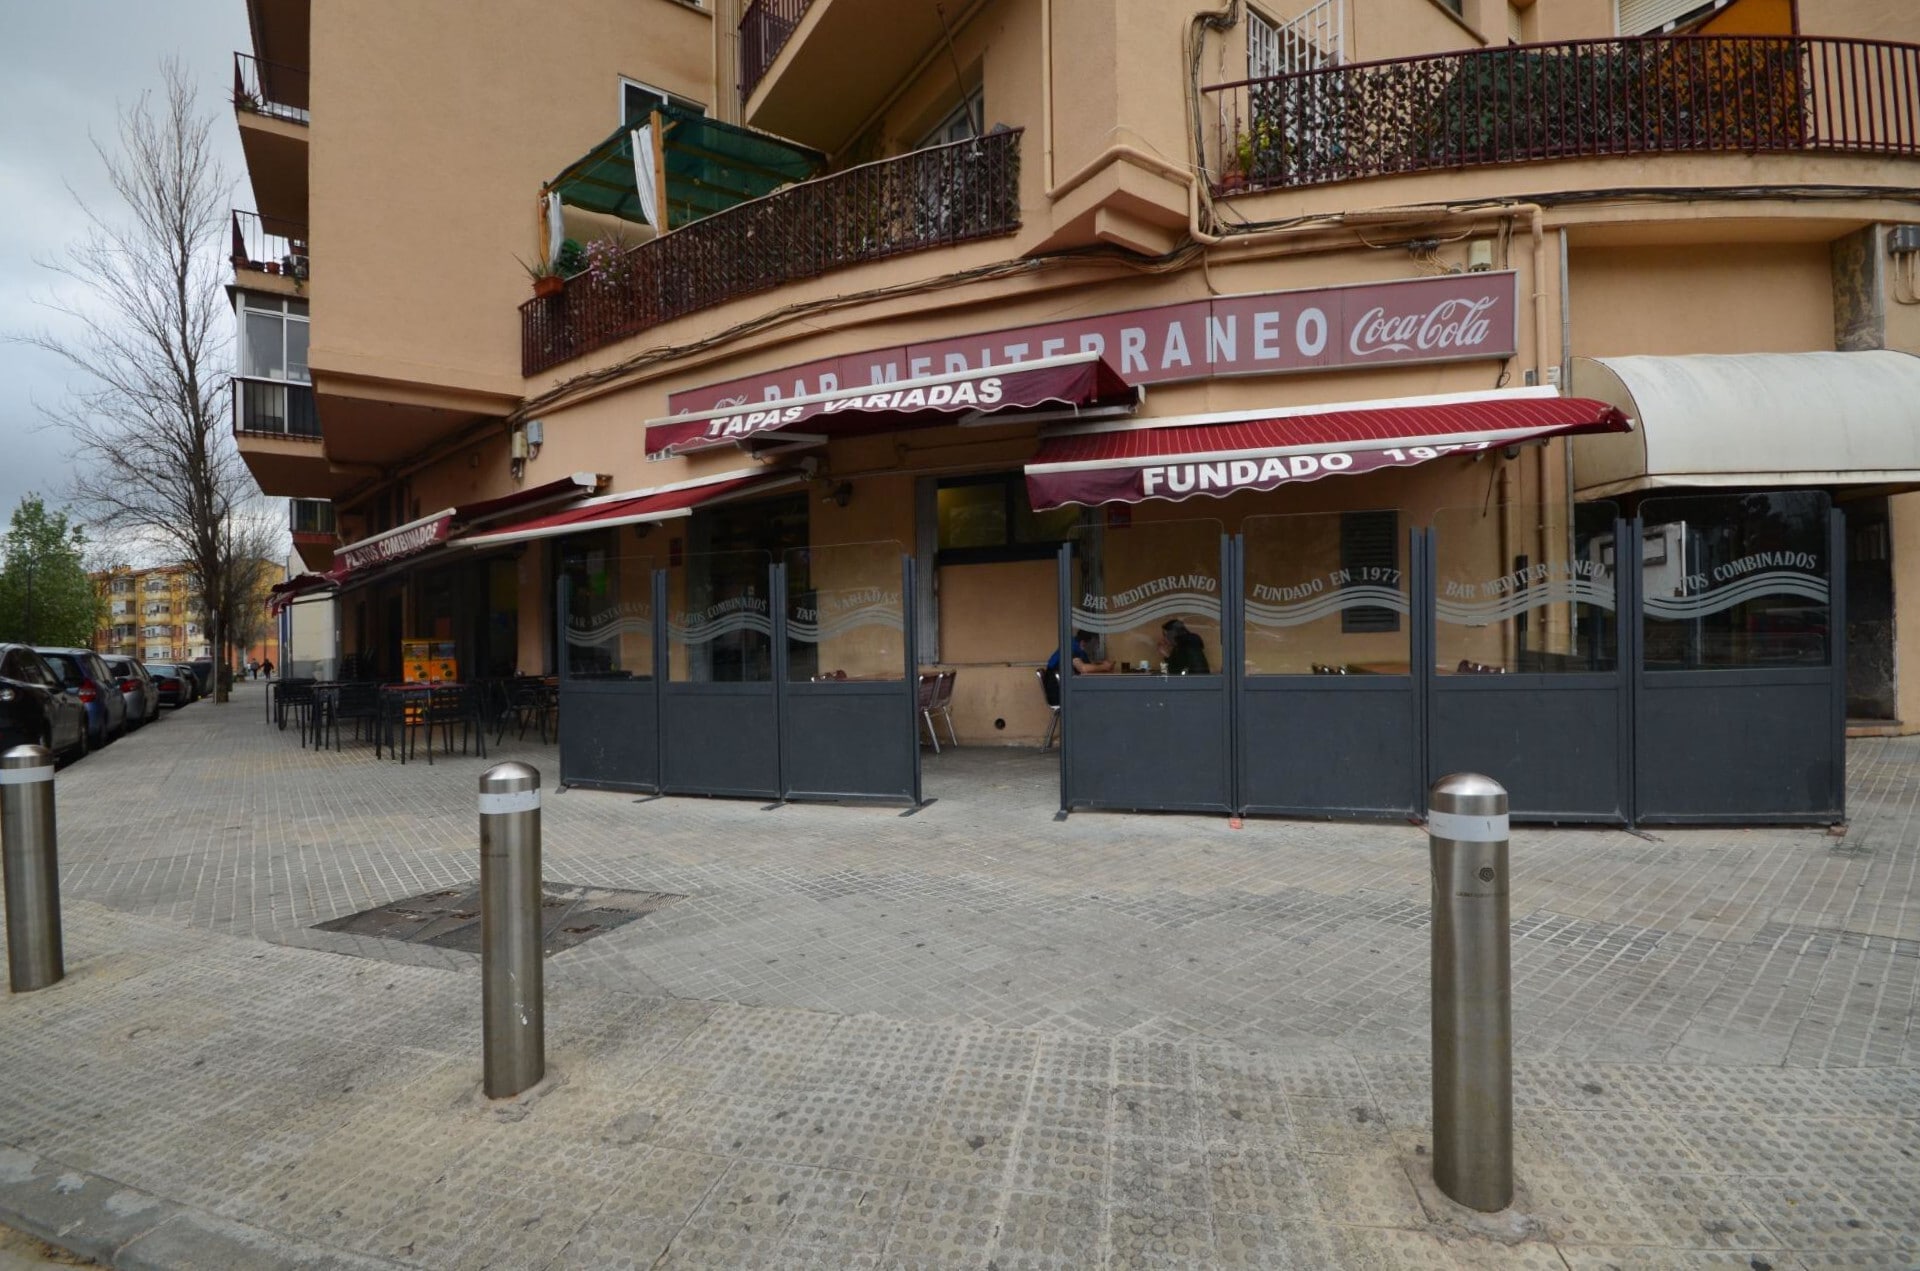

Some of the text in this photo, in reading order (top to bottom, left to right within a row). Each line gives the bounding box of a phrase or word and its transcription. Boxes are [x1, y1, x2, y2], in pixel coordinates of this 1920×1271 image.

[1350, 296, 1500, 356] Coca-Cola
[709, 377, 1003, 436] TAPAS VARIADAS
[1143, 453, 1353, 495] FUNDADO
[1252, 566, 1402, 601] FUNDADO EN 1977
[1446, 560, 1606, 599] BAR MEDITERANEO
[1713, 551, 1818, 582] COMBINADOS
[707, 596, 768, 618] COMBINADOS
[1082, 574, 1217, 610] BAR MEDITERRANEO
